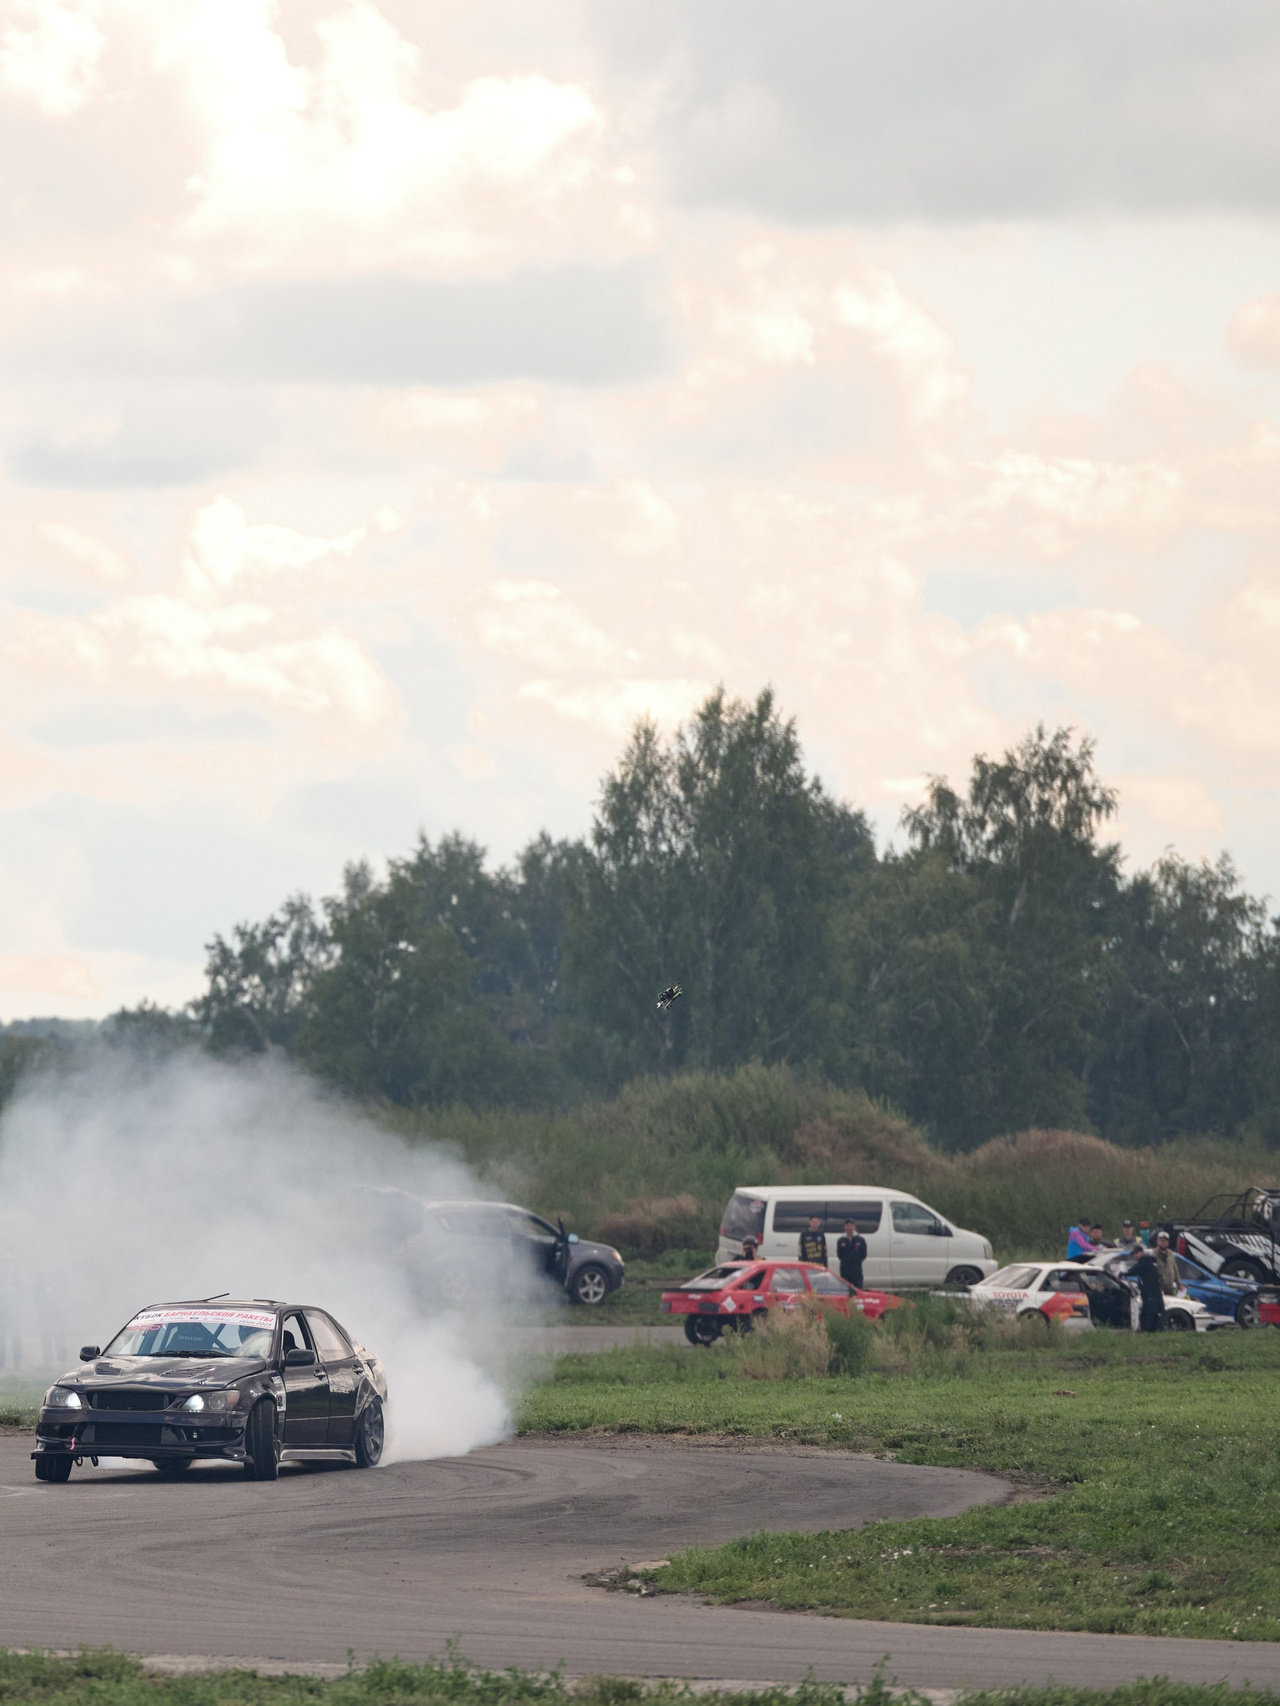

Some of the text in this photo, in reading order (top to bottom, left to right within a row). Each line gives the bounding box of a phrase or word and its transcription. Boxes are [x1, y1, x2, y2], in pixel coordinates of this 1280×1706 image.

[992, 1291, 1029, 1299] TOYOTA
[134, 1310, 274, 1322] КУБОК БАРНАУЛЬСКОЙ РАКЕТЫ
